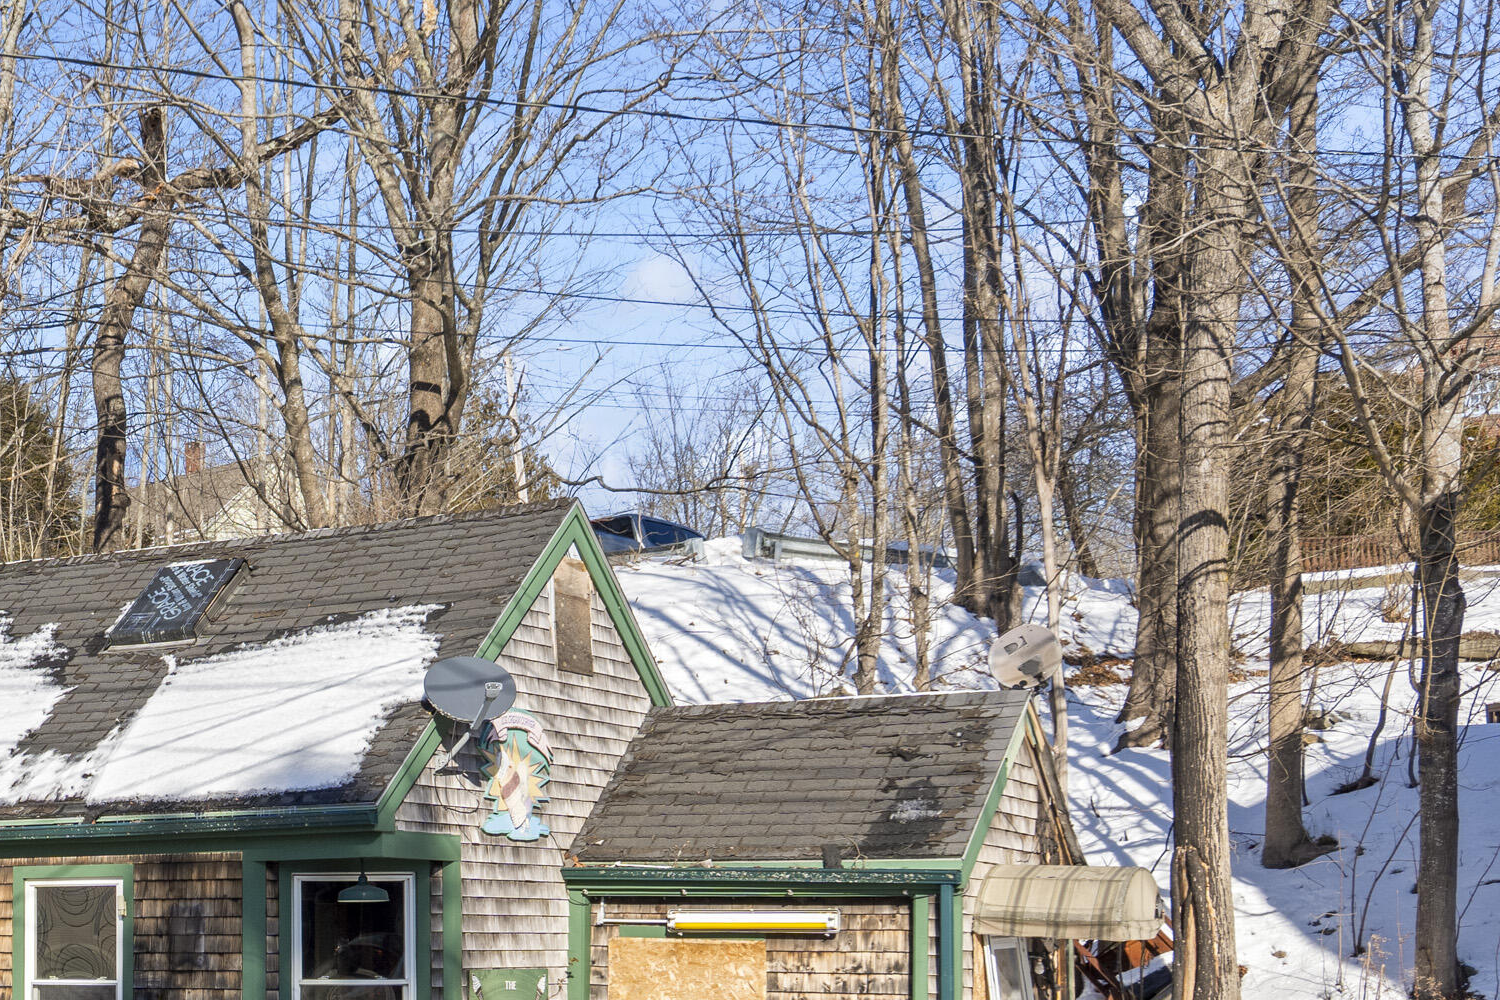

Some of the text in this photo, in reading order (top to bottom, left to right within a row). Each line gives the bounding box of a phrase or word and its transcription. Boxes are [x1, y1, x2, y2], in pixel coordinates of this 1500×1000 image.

[183, 564, 215, 586] RACE
[147, 586, 182, 620] GRACE
[504, 980, 517, 990] THE
